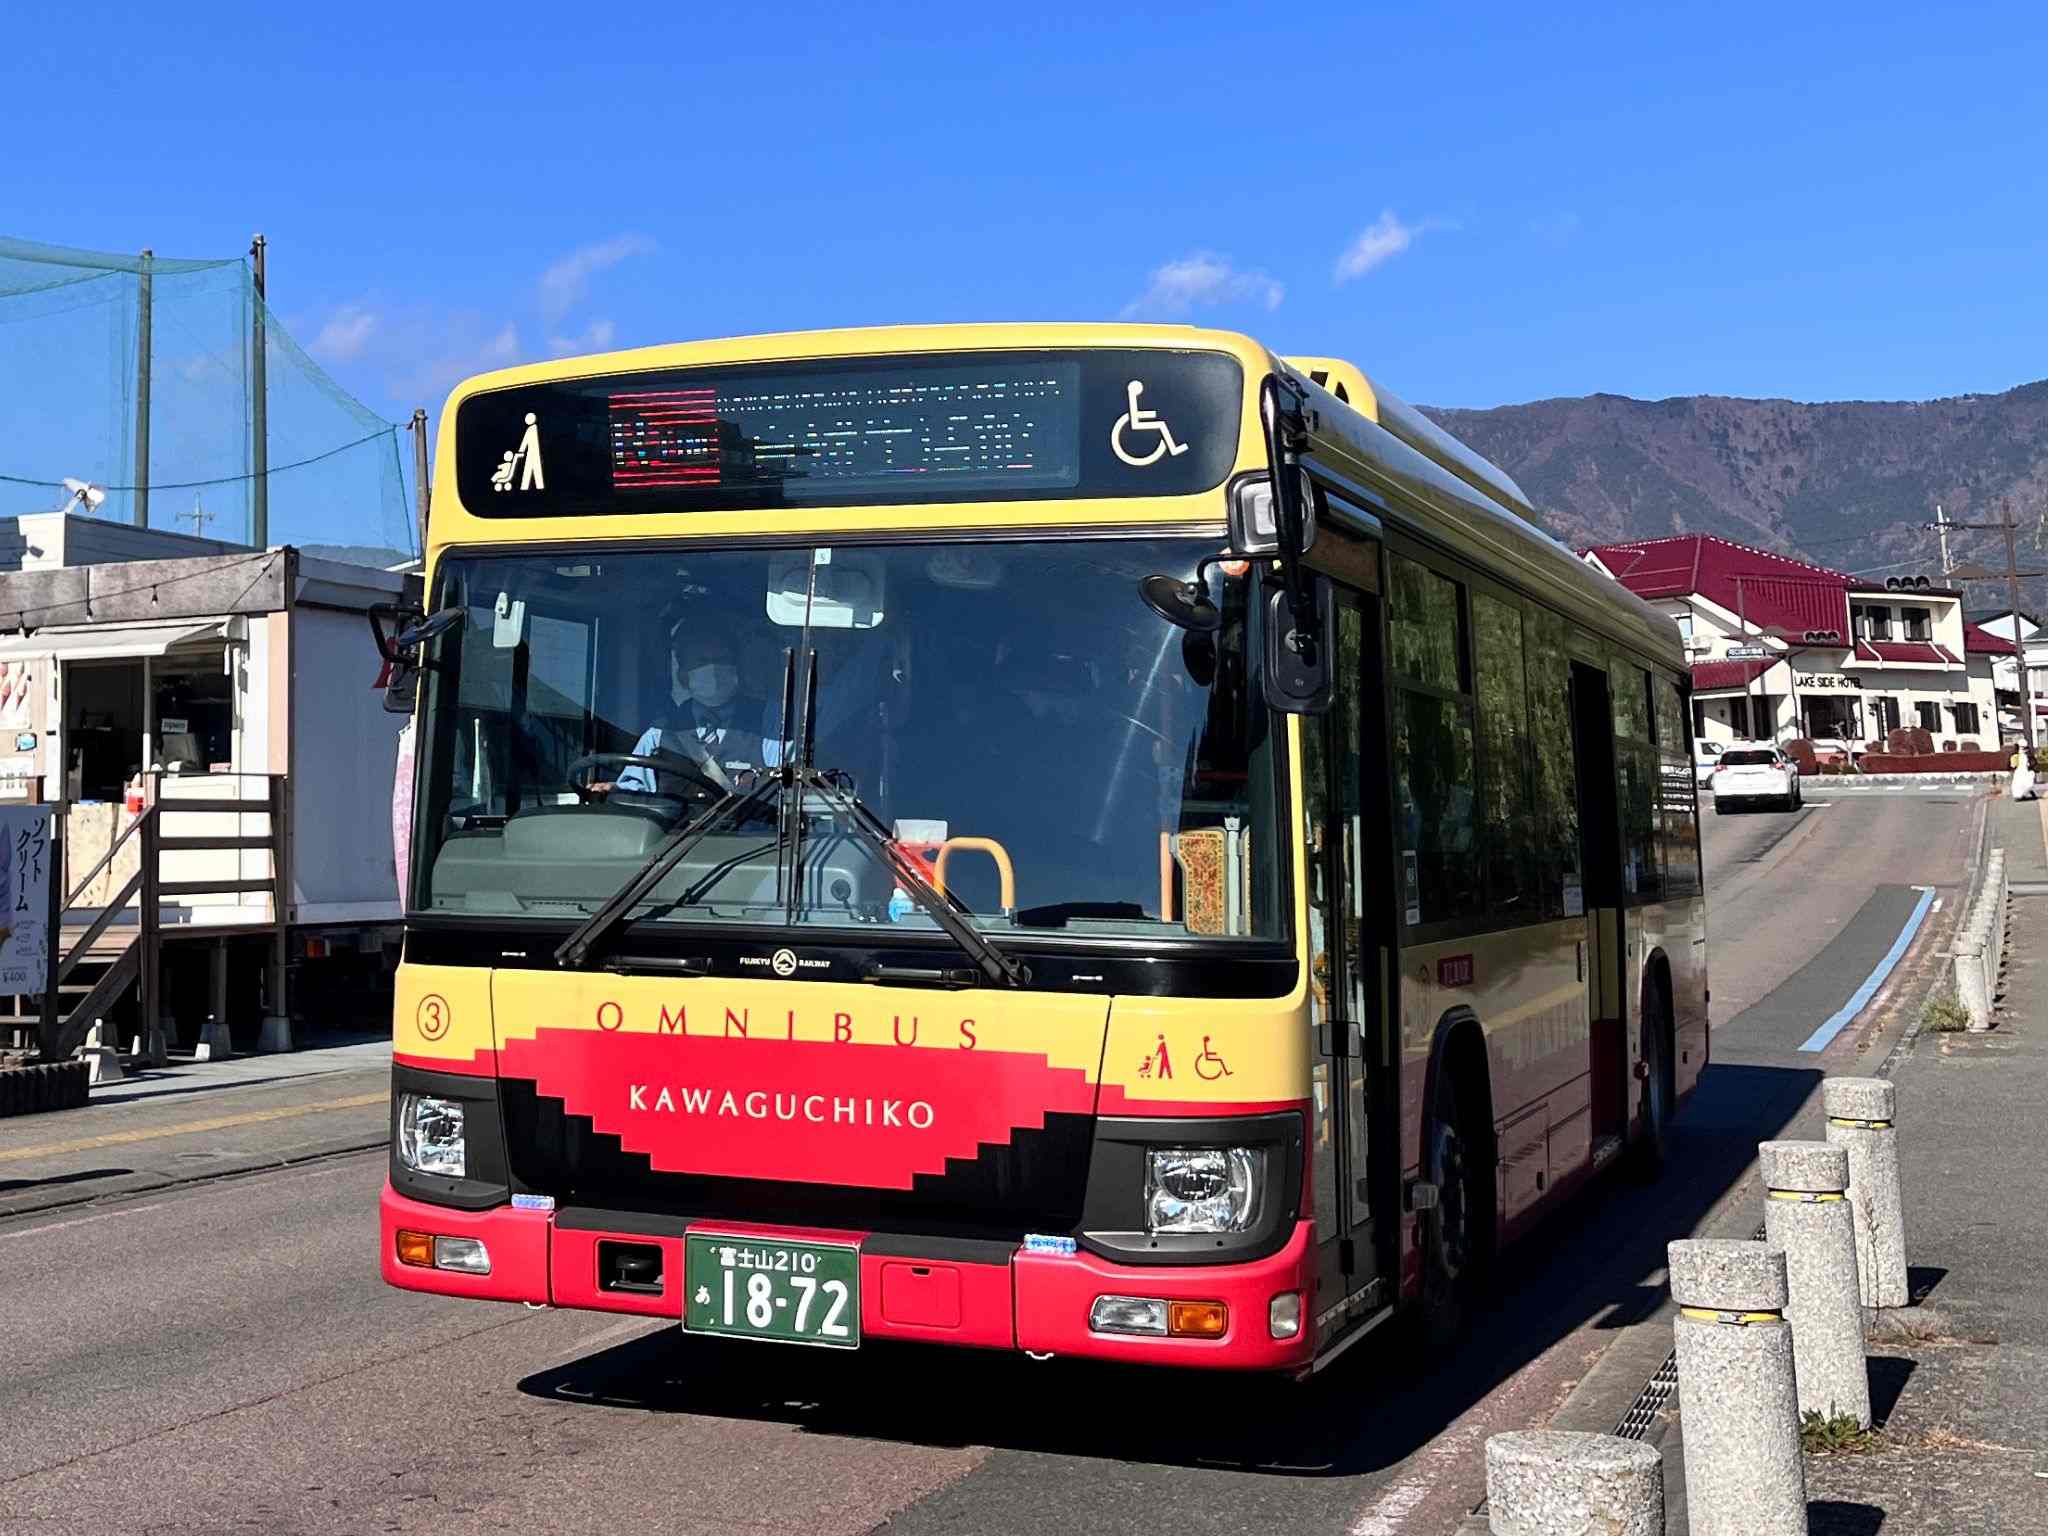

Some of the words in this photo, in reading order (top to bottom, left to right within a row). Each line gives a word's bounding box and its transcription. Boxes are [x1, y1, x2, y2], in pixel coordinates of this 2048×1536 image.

[1794, 677, 1815, 688] LAKE
[1817, 677, 1836, 688] SIDE
[1838, 677, 1863, 689] HOTEL
[16, 829, 31, 912] クリーム
[31, 817, 46, 883] ソフト
[798, 959, 831, 968] RAILWAY
[596, 1001, 977, 1051] OMNIBUS
[629, 1084, 935, 1129] KAWAGUCHIKO
[694, 1285, 711, 1305] あ
[724, 1269, 849, 1337] 18-72
